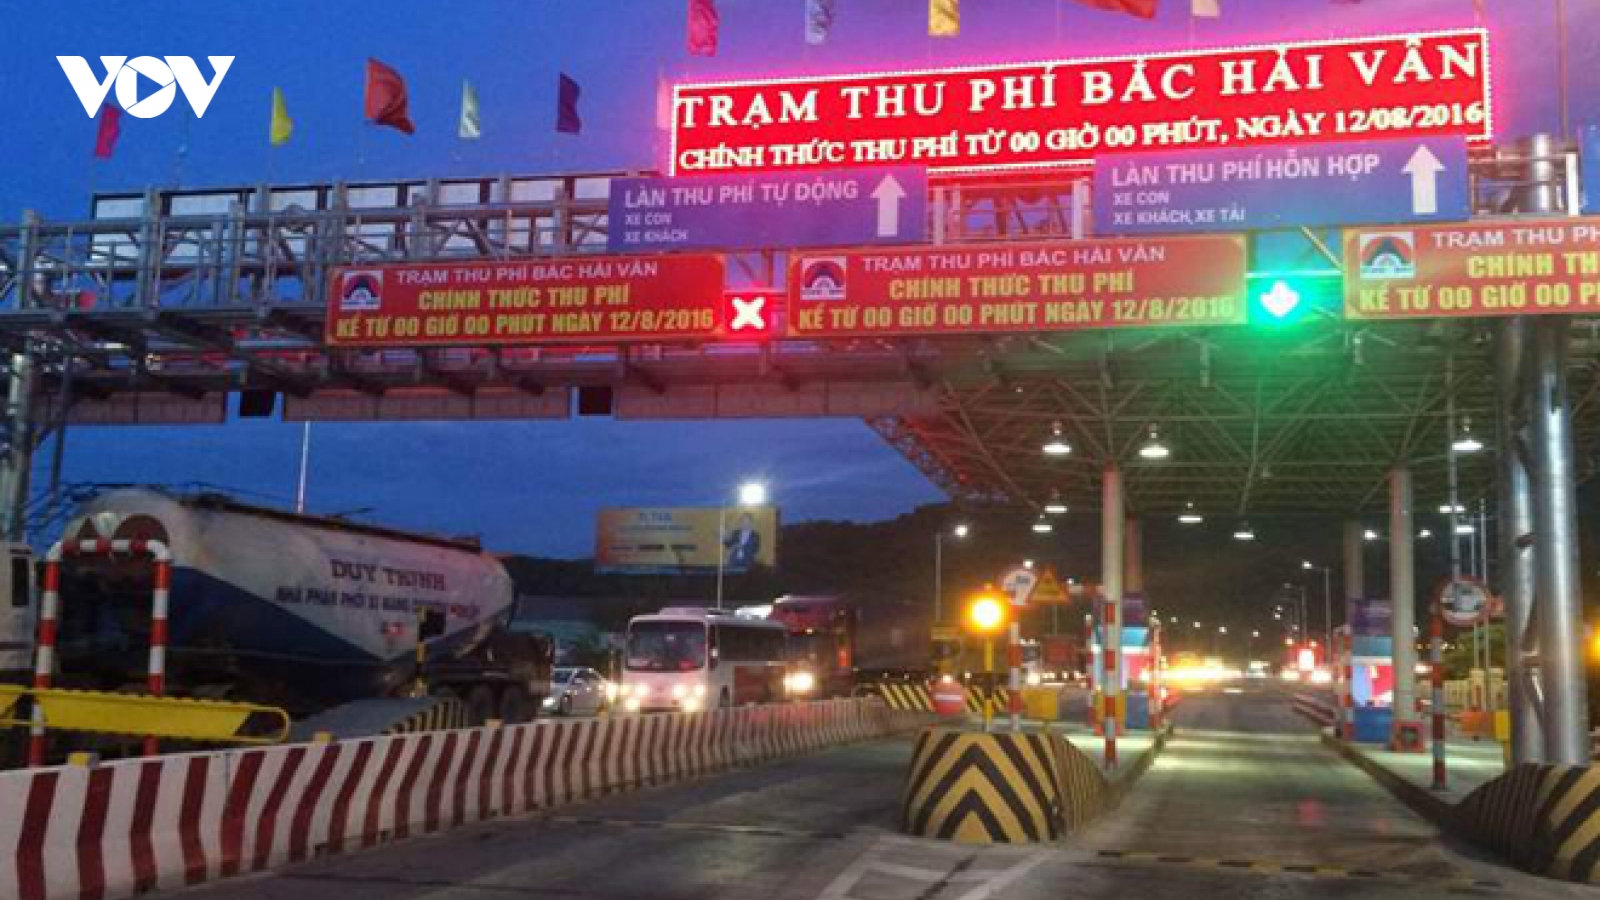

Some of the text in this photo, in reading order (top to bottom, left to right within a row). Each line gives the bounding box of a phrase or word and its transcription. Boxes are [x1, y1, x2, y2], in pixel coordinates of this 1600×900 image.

[678, 36, 1480, 129] TRẠM THU PHÍ BẮC HẢI VÂN
[679, 101, 1484, 170] CHÍNH THỨC THU PHÍ TỪ 00 GIỜ 00 PHÚT, NGÀY 12/08/2016
[1112, 149, 1381, 187] LÀN THU PHÍ HỖN HỢP
[624, 185, 666, 208] LÀN
[671, 186, 714, 206] THU
[719, 178, 753, 204] PHÍ
[761, 181, 791, 208] TỰ
[1113, 190, 1170, 206] XE CON
[624, 211, 672, 226] XE CON
[1113, 211, 1133, 226] XE
[624, 228, 688, 243] XE KHÁCH
[1433, 230, 1505, 251] TRẠM
[1511, 226, 1565, 245] THU
[862, 244, 1166, 275] TRẠM THU PHÍ BẮC HẢI VÂN
[1467, 252, 1555, 278] CHÍNH
[395, 269, 449, 288] TRẠM
[452, 267, 491, 282] THU
[496, 265, 527, 281] PHÍ
[616, 260, 658, 277] VÂN
[889, 268, 1134, 300] CHÍNH THỨC THU PHÍ
[418, 283, 631, 310] CHÍNH THỨC THU PHÍ
[980, 300, 1039, 325] PHÚT
[1044, 300, 1105, 324] NGÀY
[1112, 295, 1235, 321] 12/8/2016
[495, 310, 546, 334] PHÚT
[552, 309, 604, 332] NGÀY
[609, 308, 714, 333] 12/8/2016
[329, 558, 377, 584] DUY
